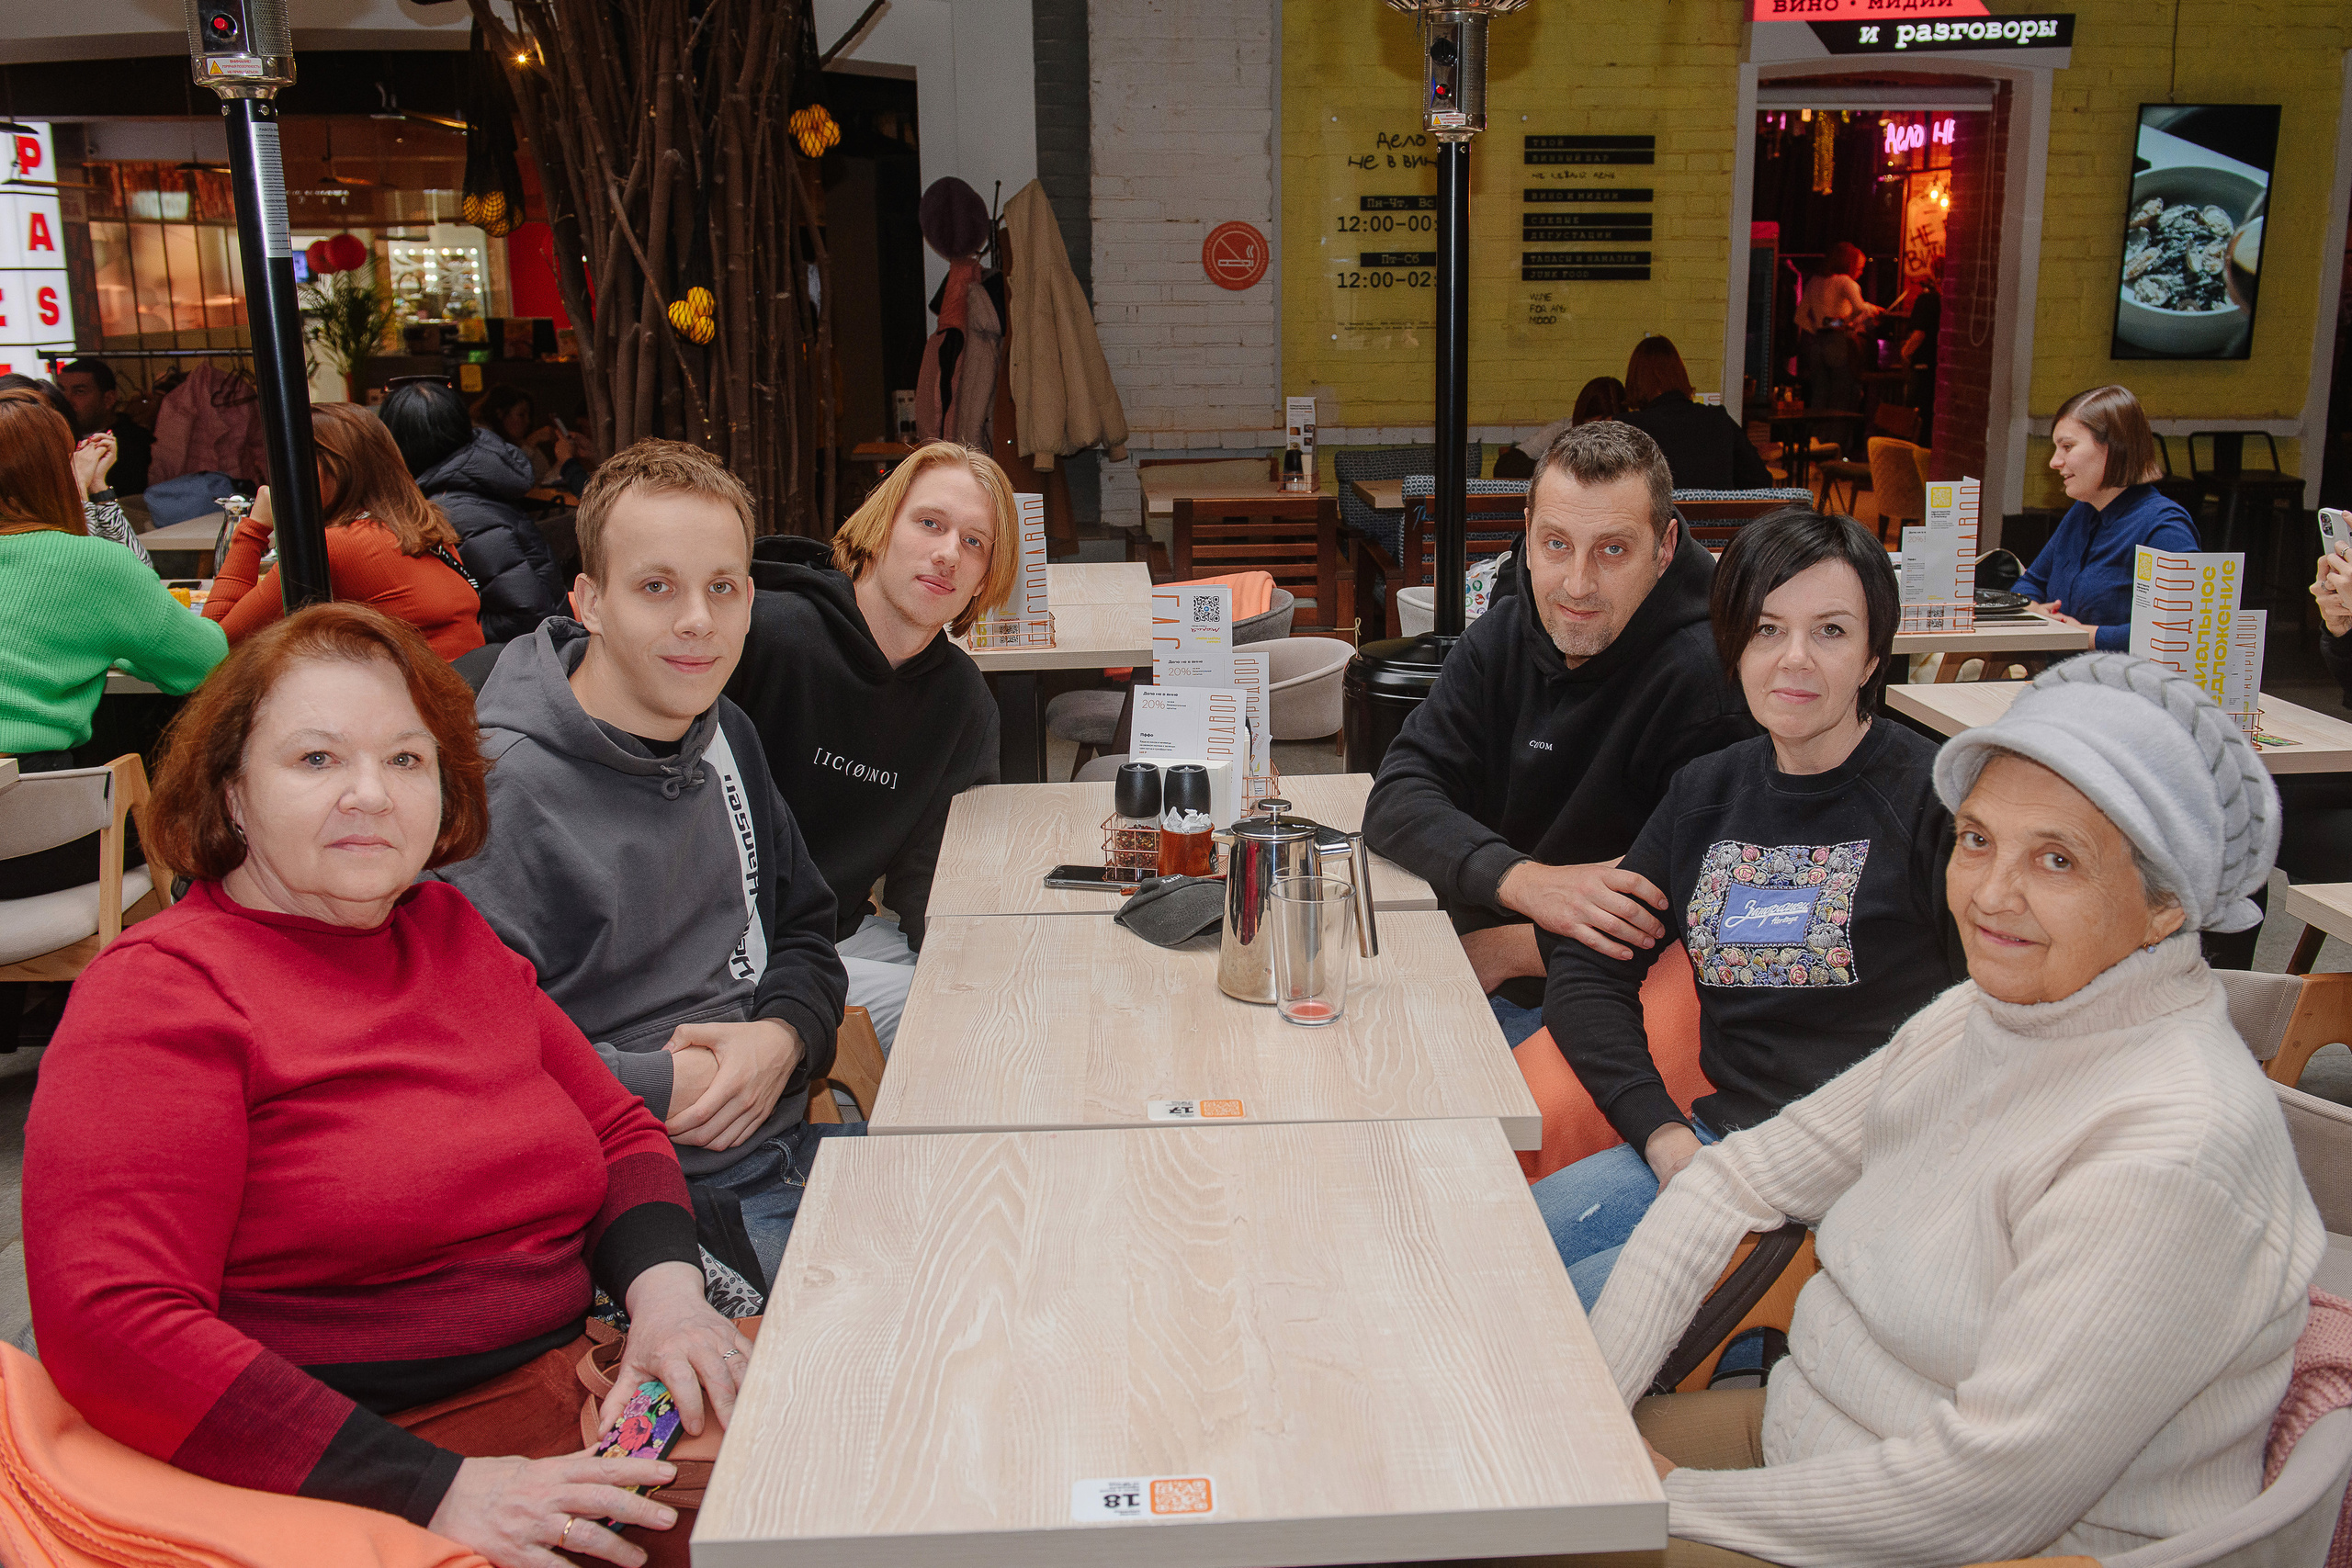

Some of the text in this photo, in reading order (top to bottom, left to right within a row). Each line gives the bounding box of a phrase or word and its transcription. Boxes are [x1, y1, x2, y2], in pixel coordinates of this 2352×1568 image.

[1859, 19, 2059, 49] и разговоры
[1386, 154, 1396, 169] в
[1402, 153, 1438, 170] вин
[1418, 197, 1434, 208] Вс
[1530, 231, 1612, 241] ДЕГУСТАЦИИ
[1562, 270, 1589, 278] FOOD
[1168, 667, 1192, 676] 20%
[1142, 699, 1166, 710] 20%
[1168, 1106, 1194, 1114] 17
[1103, 1493, 1140, 1508] 18
